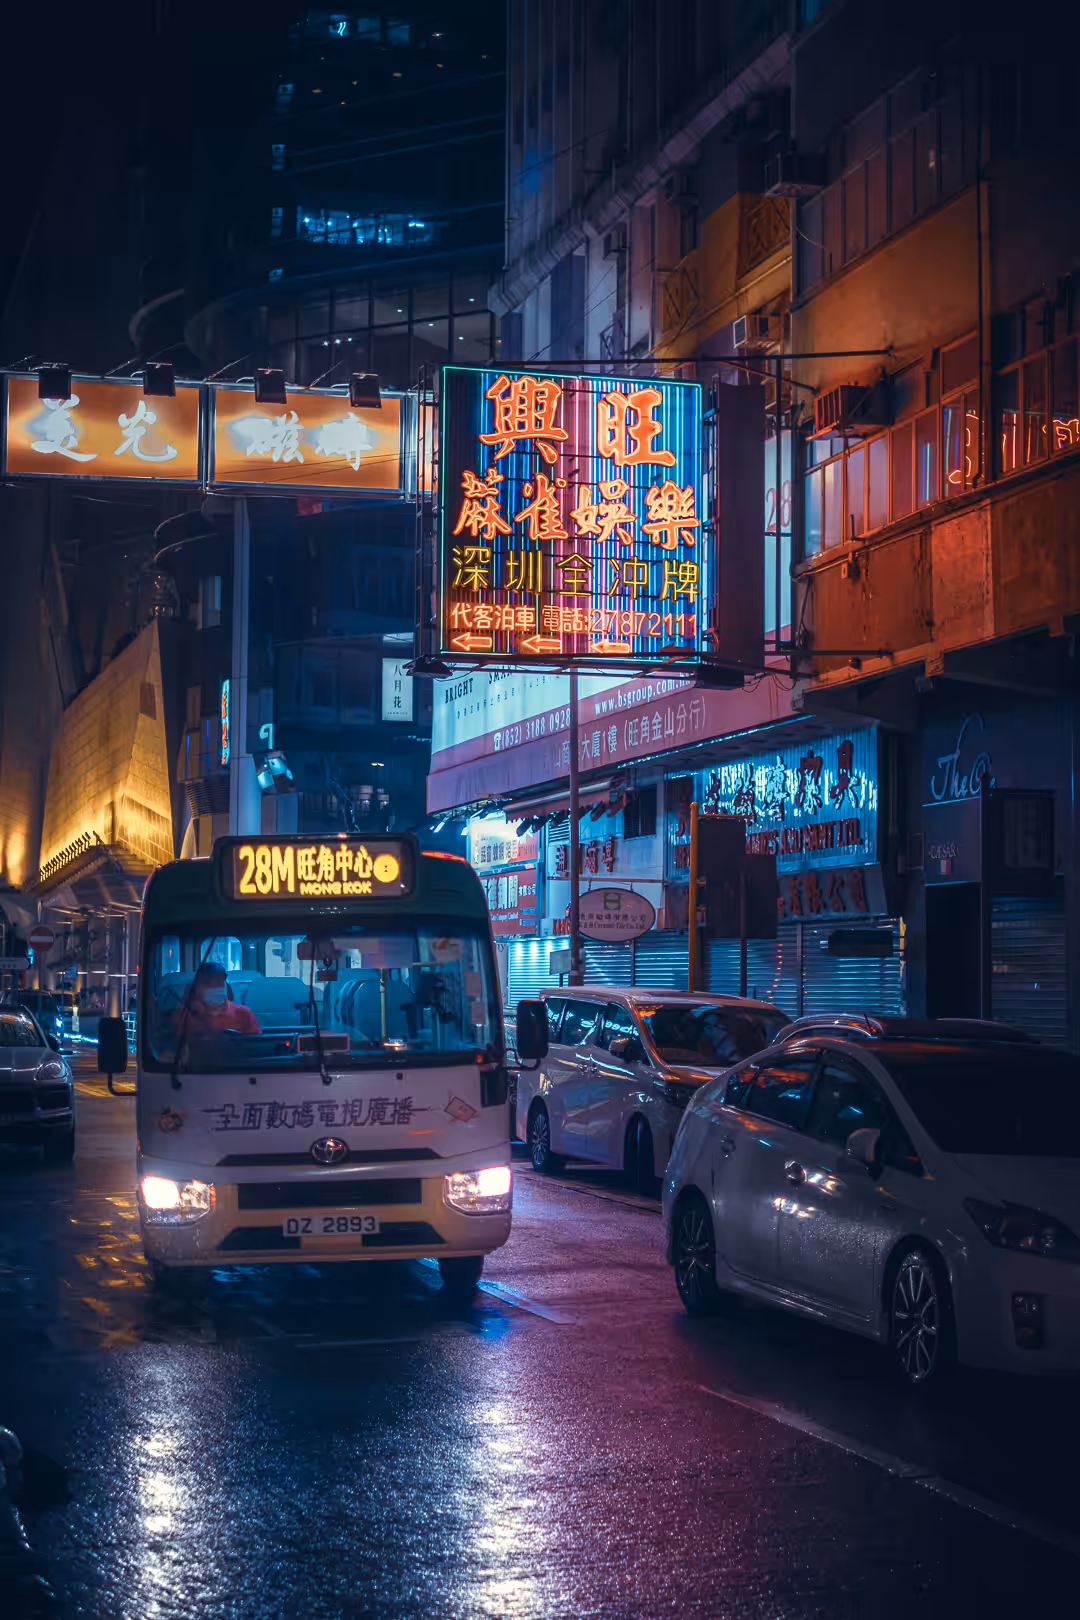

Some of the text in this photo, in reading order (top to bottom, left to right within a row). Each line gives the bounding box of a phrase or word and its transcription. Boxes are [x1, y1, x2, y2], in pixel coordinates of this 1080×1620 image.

[479, 375, 677, 466] 興旺
[451, 602, 536, 632] 代客泊車
[394, 664, 402, 708] 八月花
[445, 678, 474, 704] BRIGHT
[501, 707, 571, 750] (852) 3188 0928
[624, 696, 706, 750] (旺角金山分行)
[239, 845, 295, 894] 28M
[297, 843, 373, 882] 旺角中心
[301, 881, 372, 895] MONG KOK
[287, 1216, 376, 1234] DZ 2893
